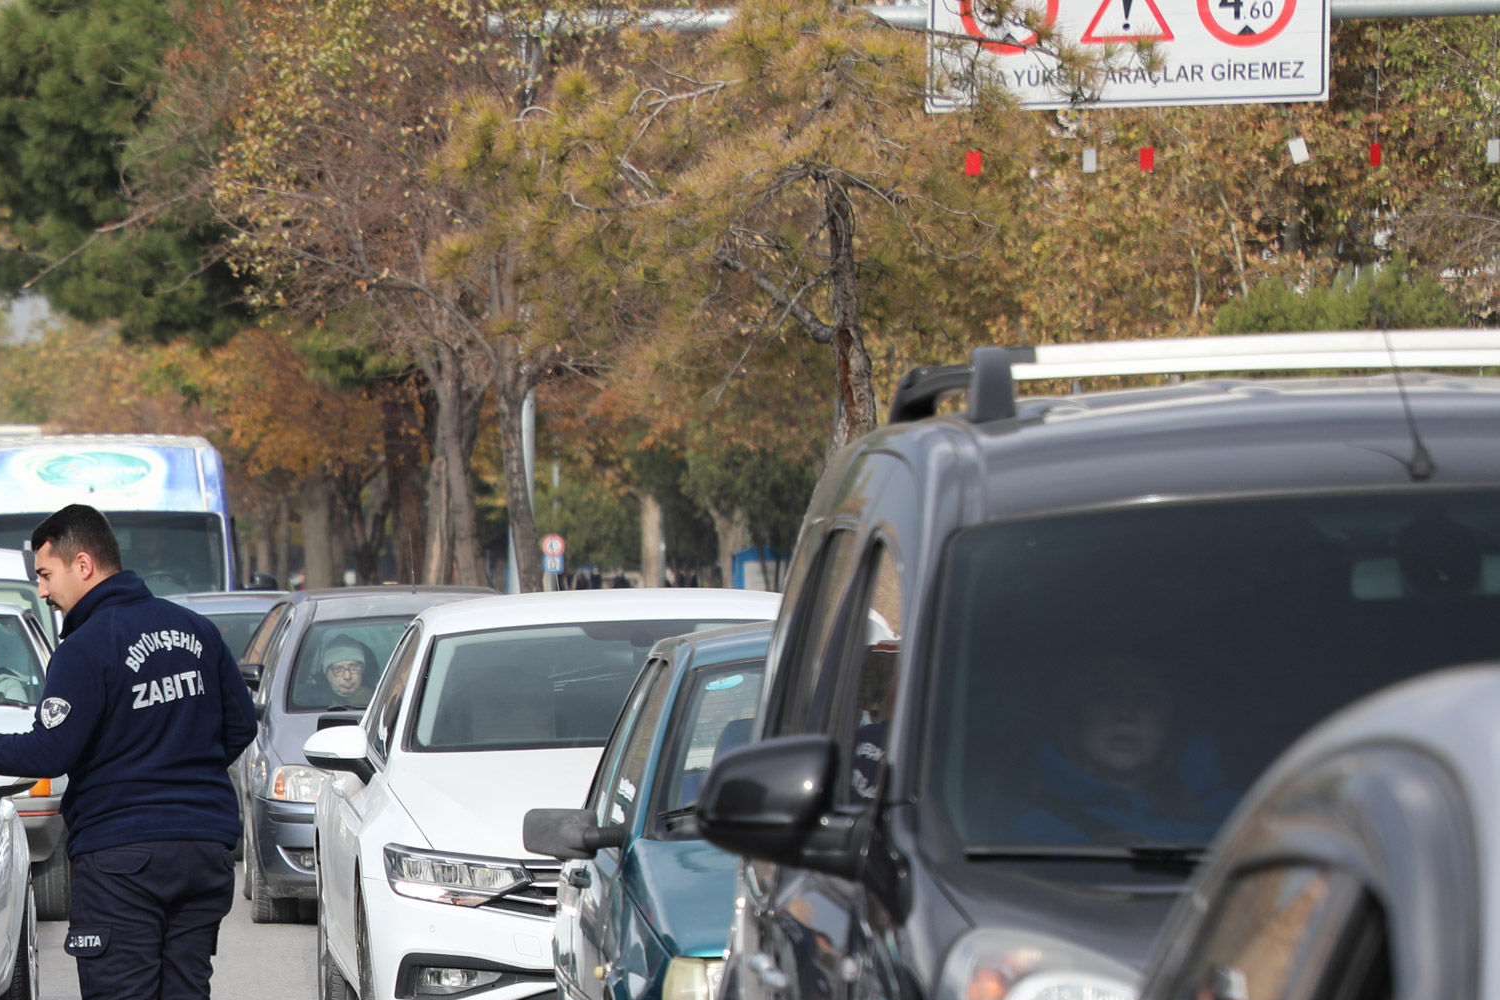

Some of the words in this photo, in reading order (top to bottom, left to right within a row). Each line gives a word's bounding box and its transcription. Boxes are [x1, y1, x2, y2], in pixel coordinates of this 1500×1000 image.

[1013, 64, 1098, 87] YÜKS
[1211, 59, 1305, 82] GİREMEZ
[125, 629, 203, 673] BÜYÜKŞEHİR
[131, 670, 205, 710] ZABITA
